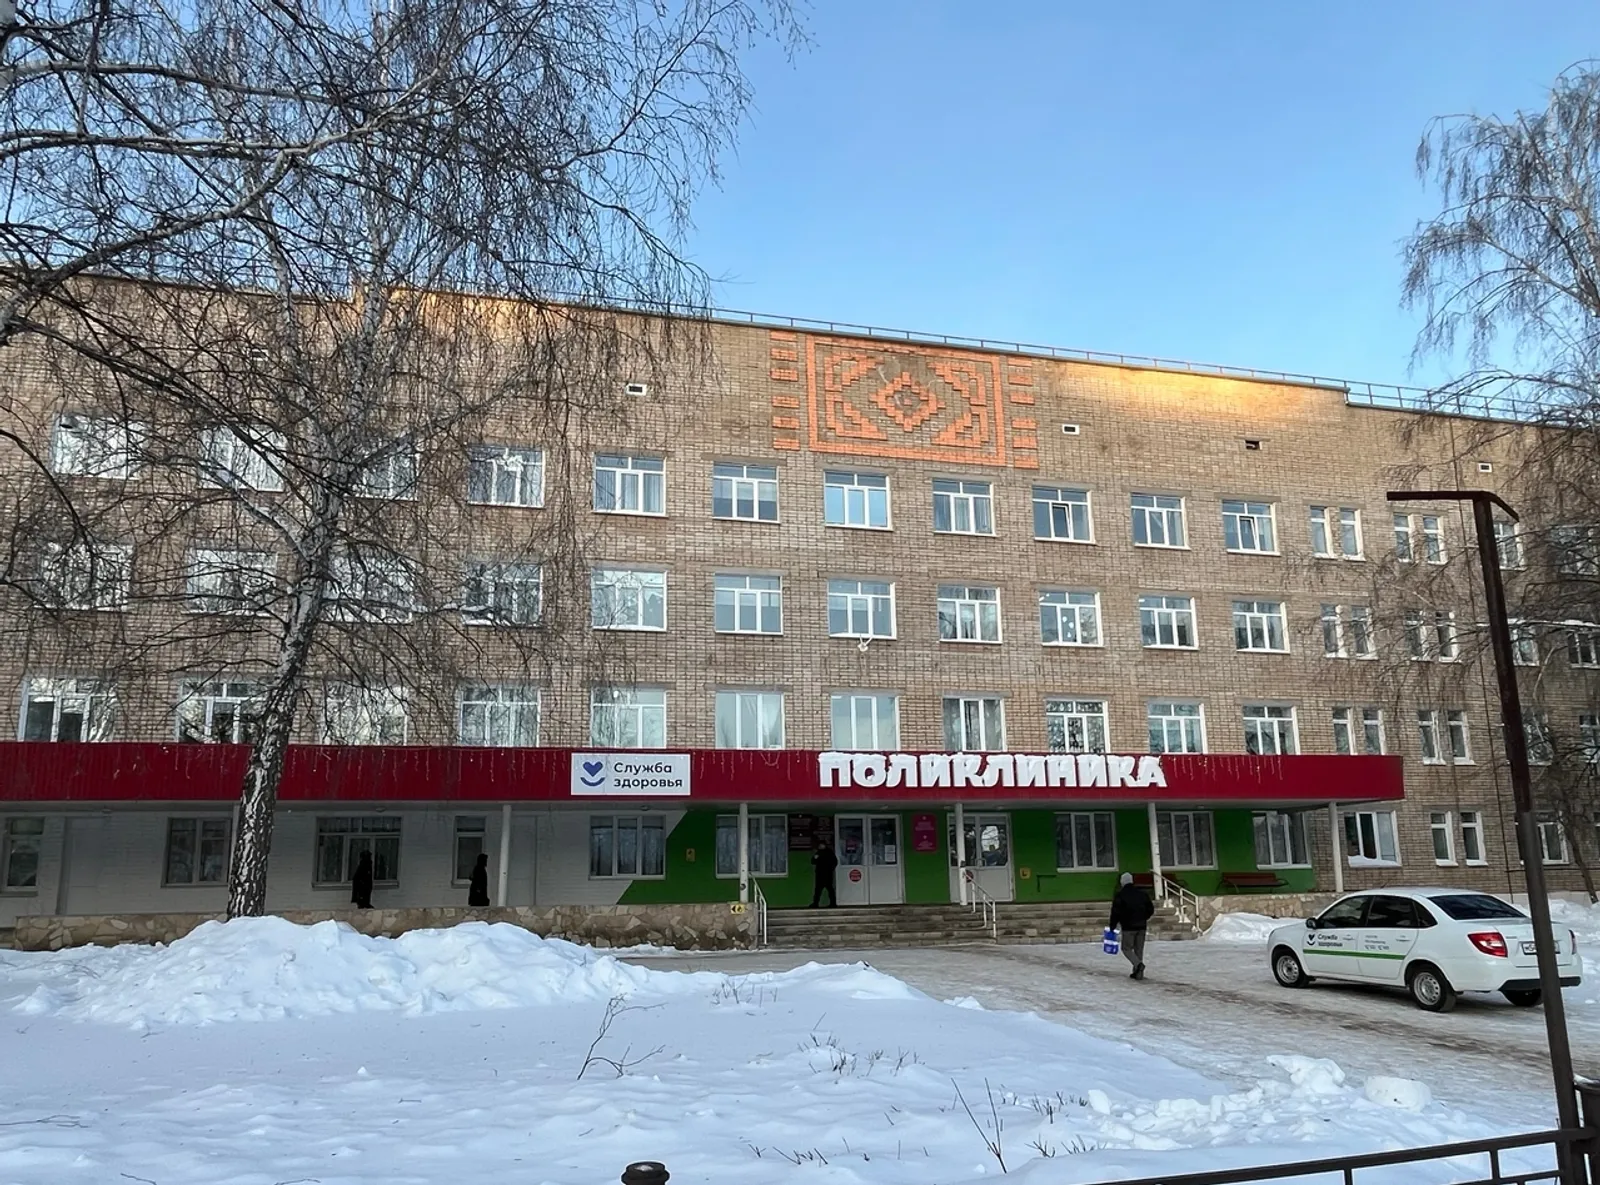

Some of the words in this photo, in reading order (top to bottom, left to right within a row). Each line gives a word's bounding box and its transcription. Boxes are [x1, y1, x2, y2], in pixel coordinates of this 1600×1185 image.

[613, 762, 672, 775] Служба
[818, 752, 1167, 787] ПОЛИКЛИНИКА
[613, 779, 682, 789] здоровья
